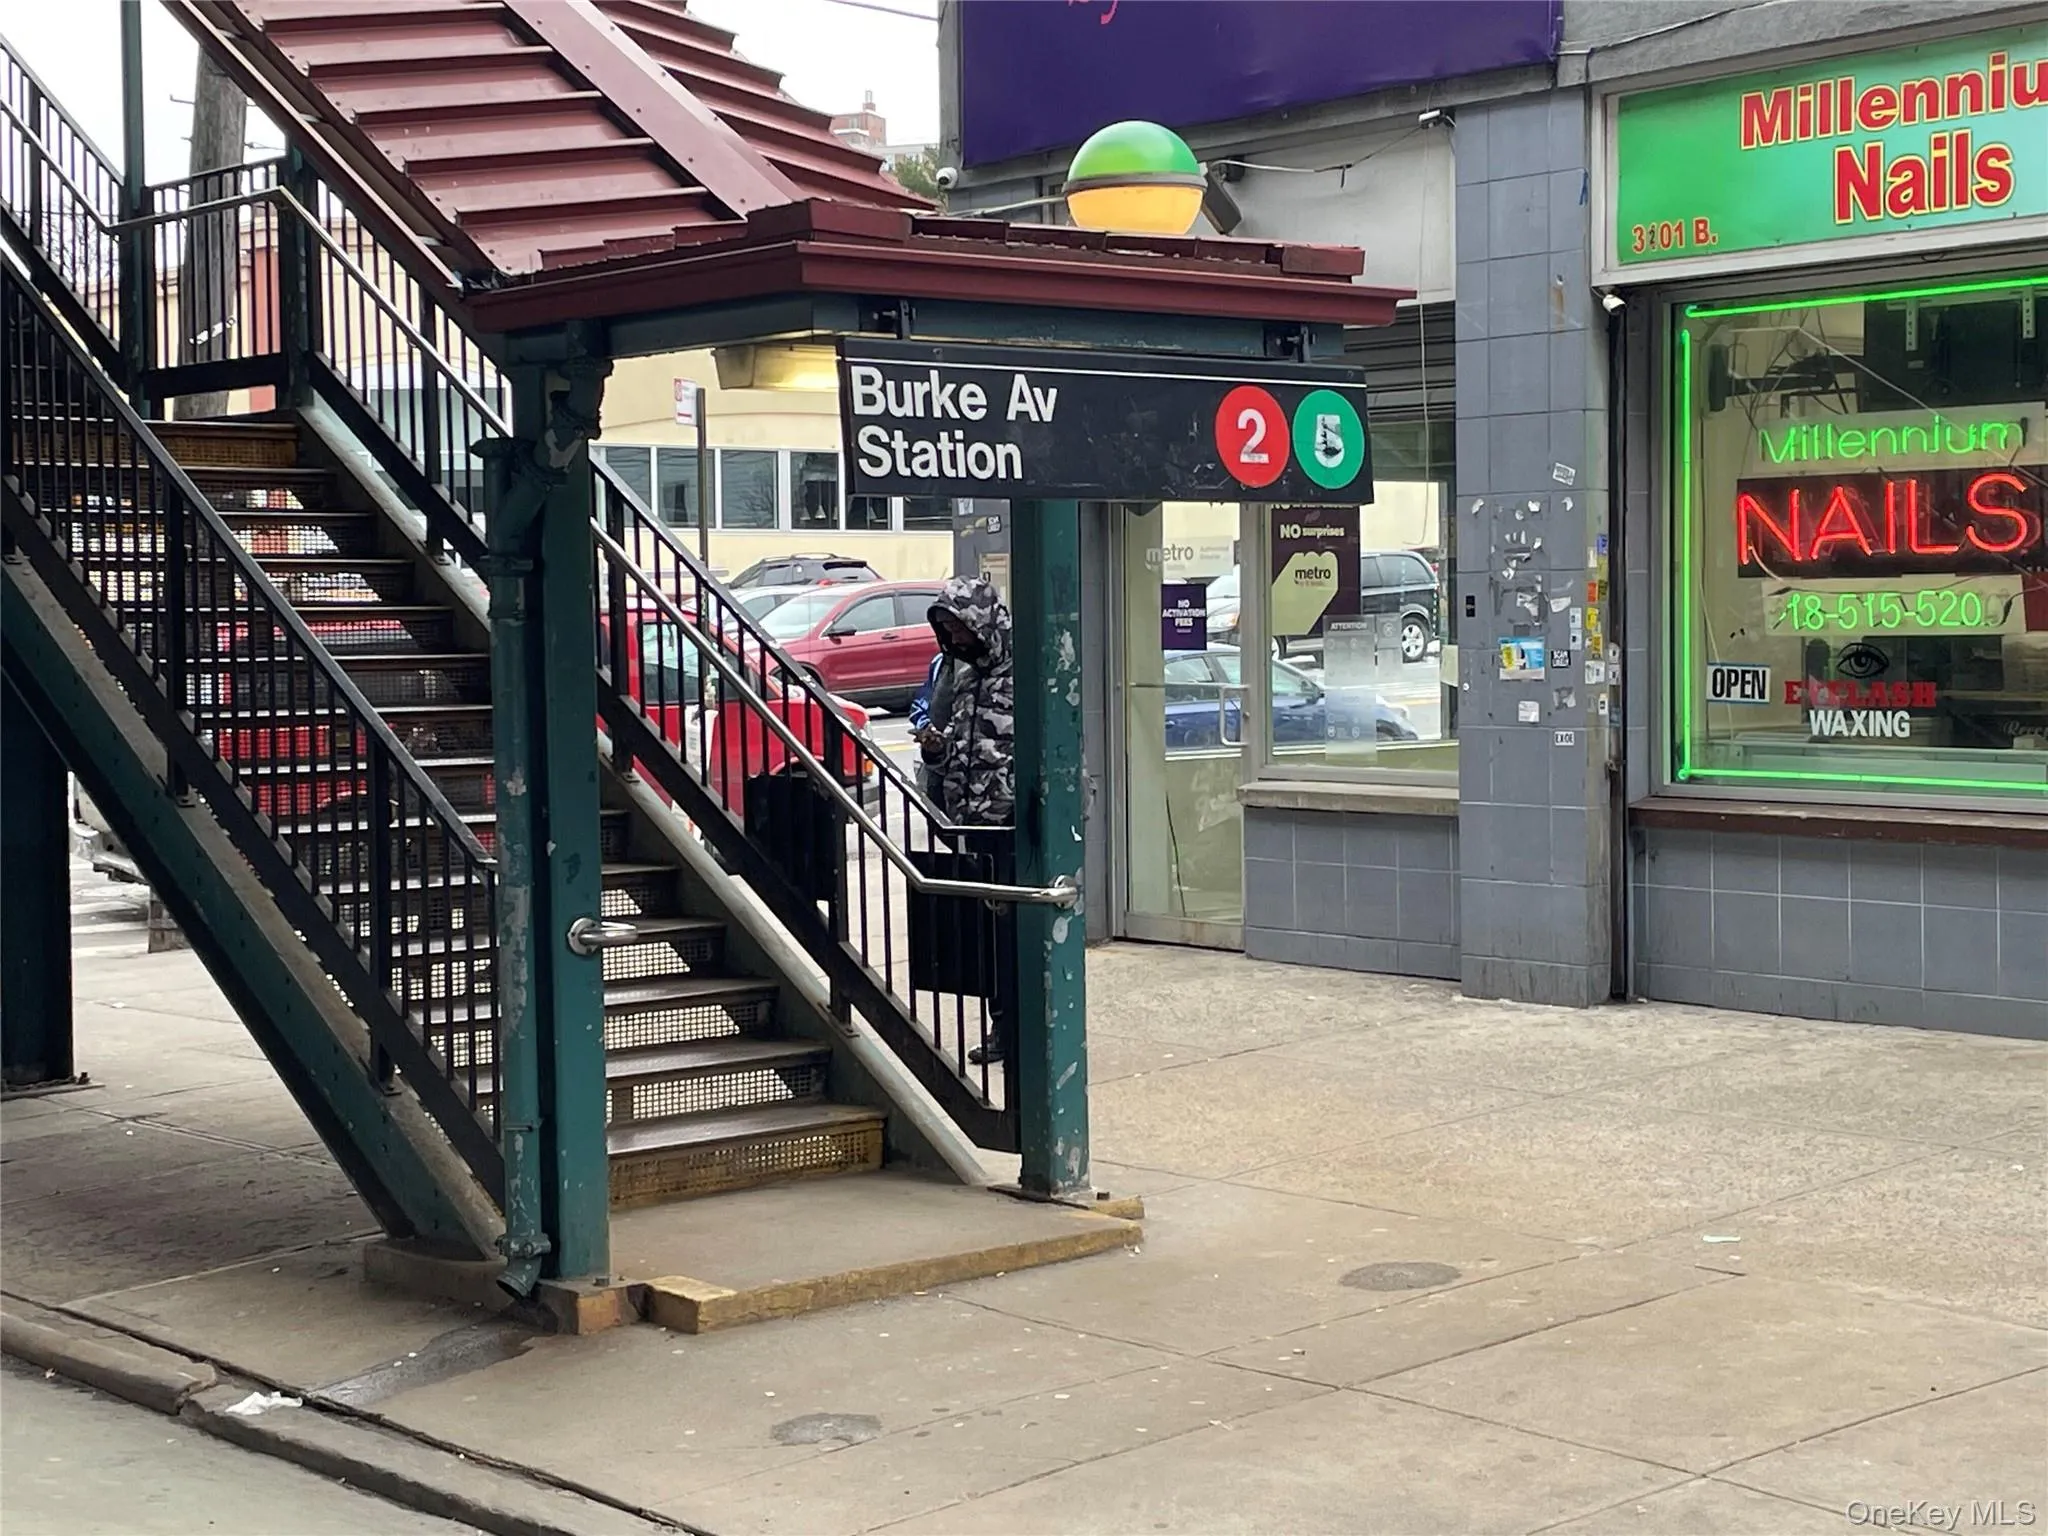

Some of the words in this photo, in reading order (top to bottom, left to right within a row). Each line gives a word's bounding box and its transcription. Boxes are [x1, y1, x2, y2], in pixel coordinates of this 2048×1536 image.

[1834, 128, 2014, 224] Nails
[851, 365, 987, 421] Burke
[1006, 373, 1058, 422] Av
[1237, 408, 1270, 464] 2
[1760, 415, 2028, 463] Millennium
[857, 425, 1023, 480] Station
[1280, 524, 1300, 539] NO
[1302, 524, 1344, 539] surprises
[1736, 472, 2029, 566] NAILS
[1294, 566, 1331, 580] metro
[1162, 608, 1206, 617] ACTIVATION
[1177, 599, 1190, 608] NO
[1175, 617, 1193, 627] FEES
[1330, 621, 1368, 631] ATTENTION
[1711, 668, 1767, 700] OPEN
[1809, 710, 1911, 738] WAXING
